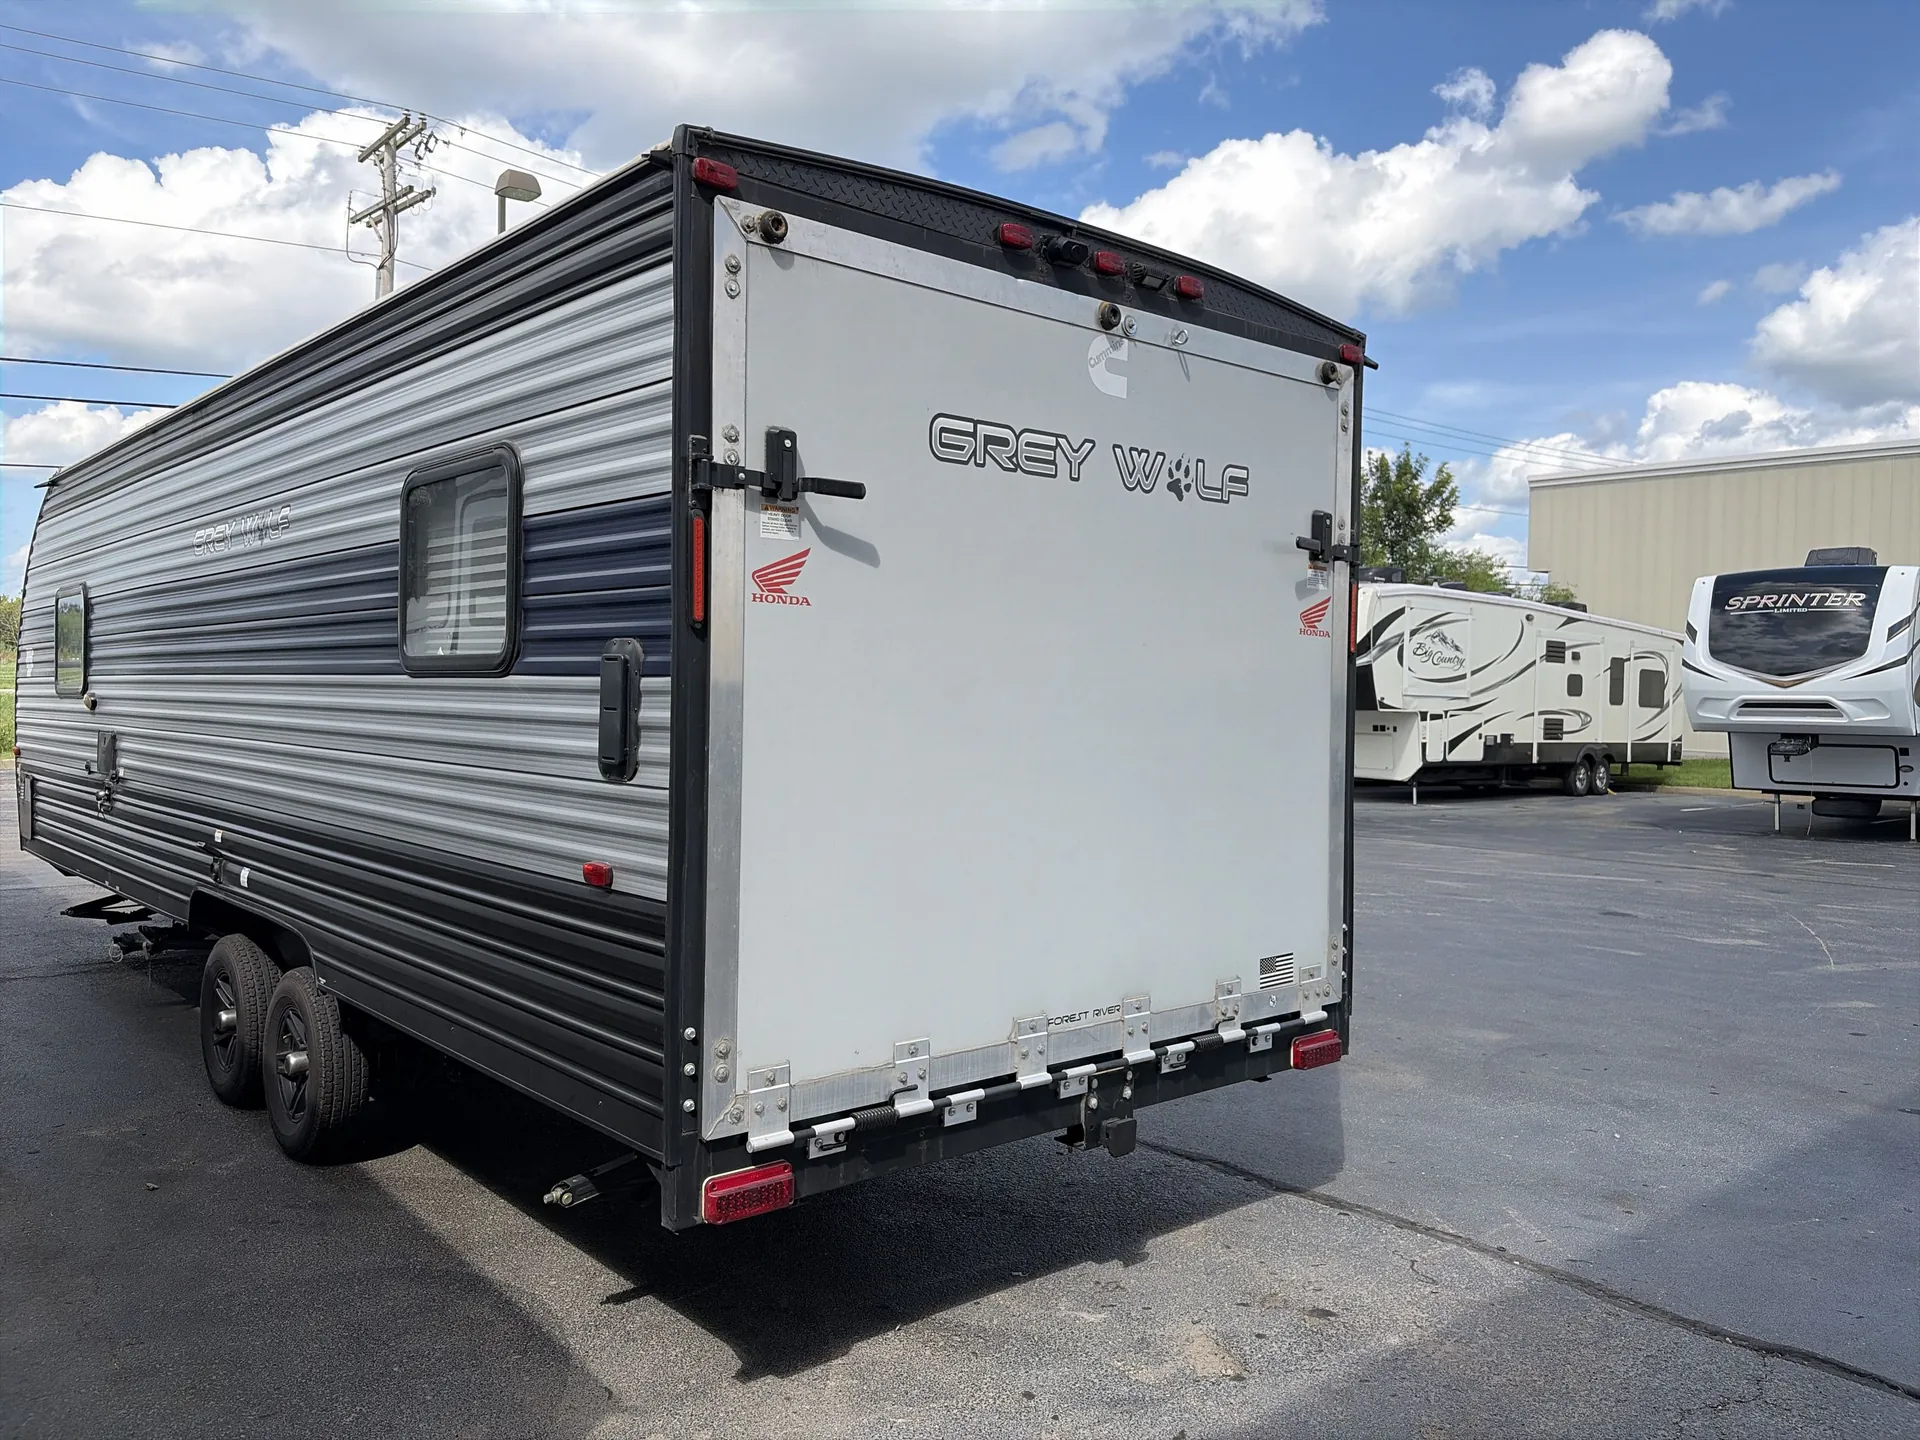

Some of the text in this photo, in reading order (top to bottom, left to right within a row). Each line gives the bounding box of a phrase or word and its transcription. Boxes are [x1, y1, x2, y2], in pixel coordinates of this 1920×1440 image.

[929, 412, 1249, 504] GREY WLF
[192, 504, 291, 557] GREY WLF
[751, 592, 812, 607] HONDA
[1724, 592, 1866, 611] SPRINTER
[1299, 628, 1331, 638] HONDA
[1412, 642, 1467, 672] Big Country
[1047, 1004, 1121, 1027] FOREST RIVER
